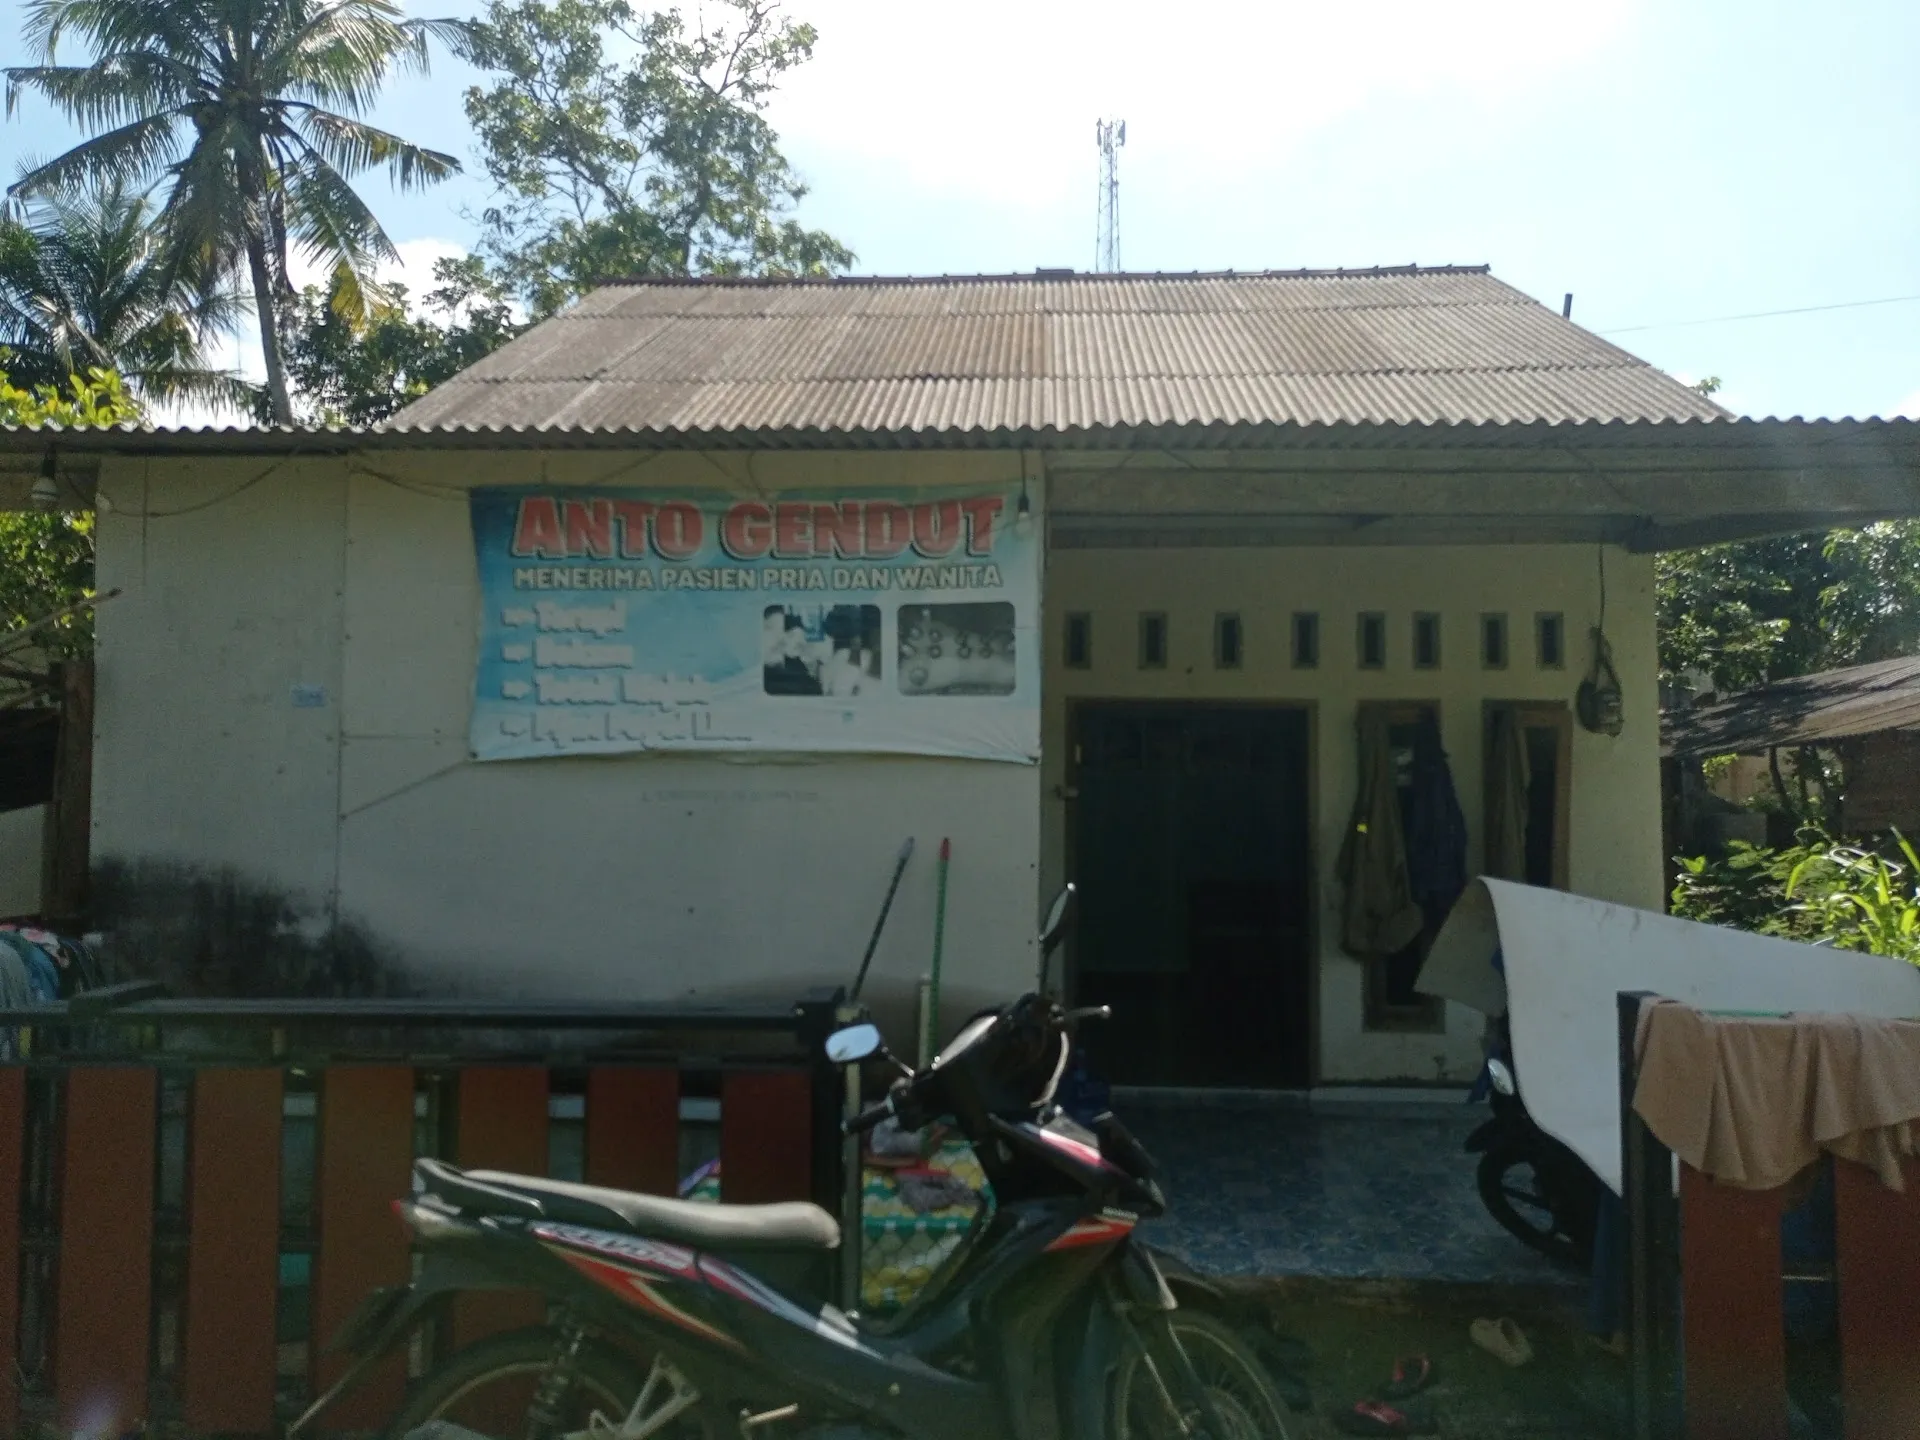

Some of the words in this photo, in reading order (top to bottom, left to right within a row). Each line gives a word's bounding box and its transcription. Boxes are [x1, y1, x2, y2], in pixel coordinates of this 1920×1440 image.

[513, 497, 704, 560] ANTO
[720, 495, 1004, 559] GENDUT
[515, 568, 652, 590] MENERIMA
[662, 568, 757, 590] PASIEN
[763, 568, 826, 590] PRIA
[834, 568, 892, 590] DAN
[896, 566, 1003, 589] WANITA
